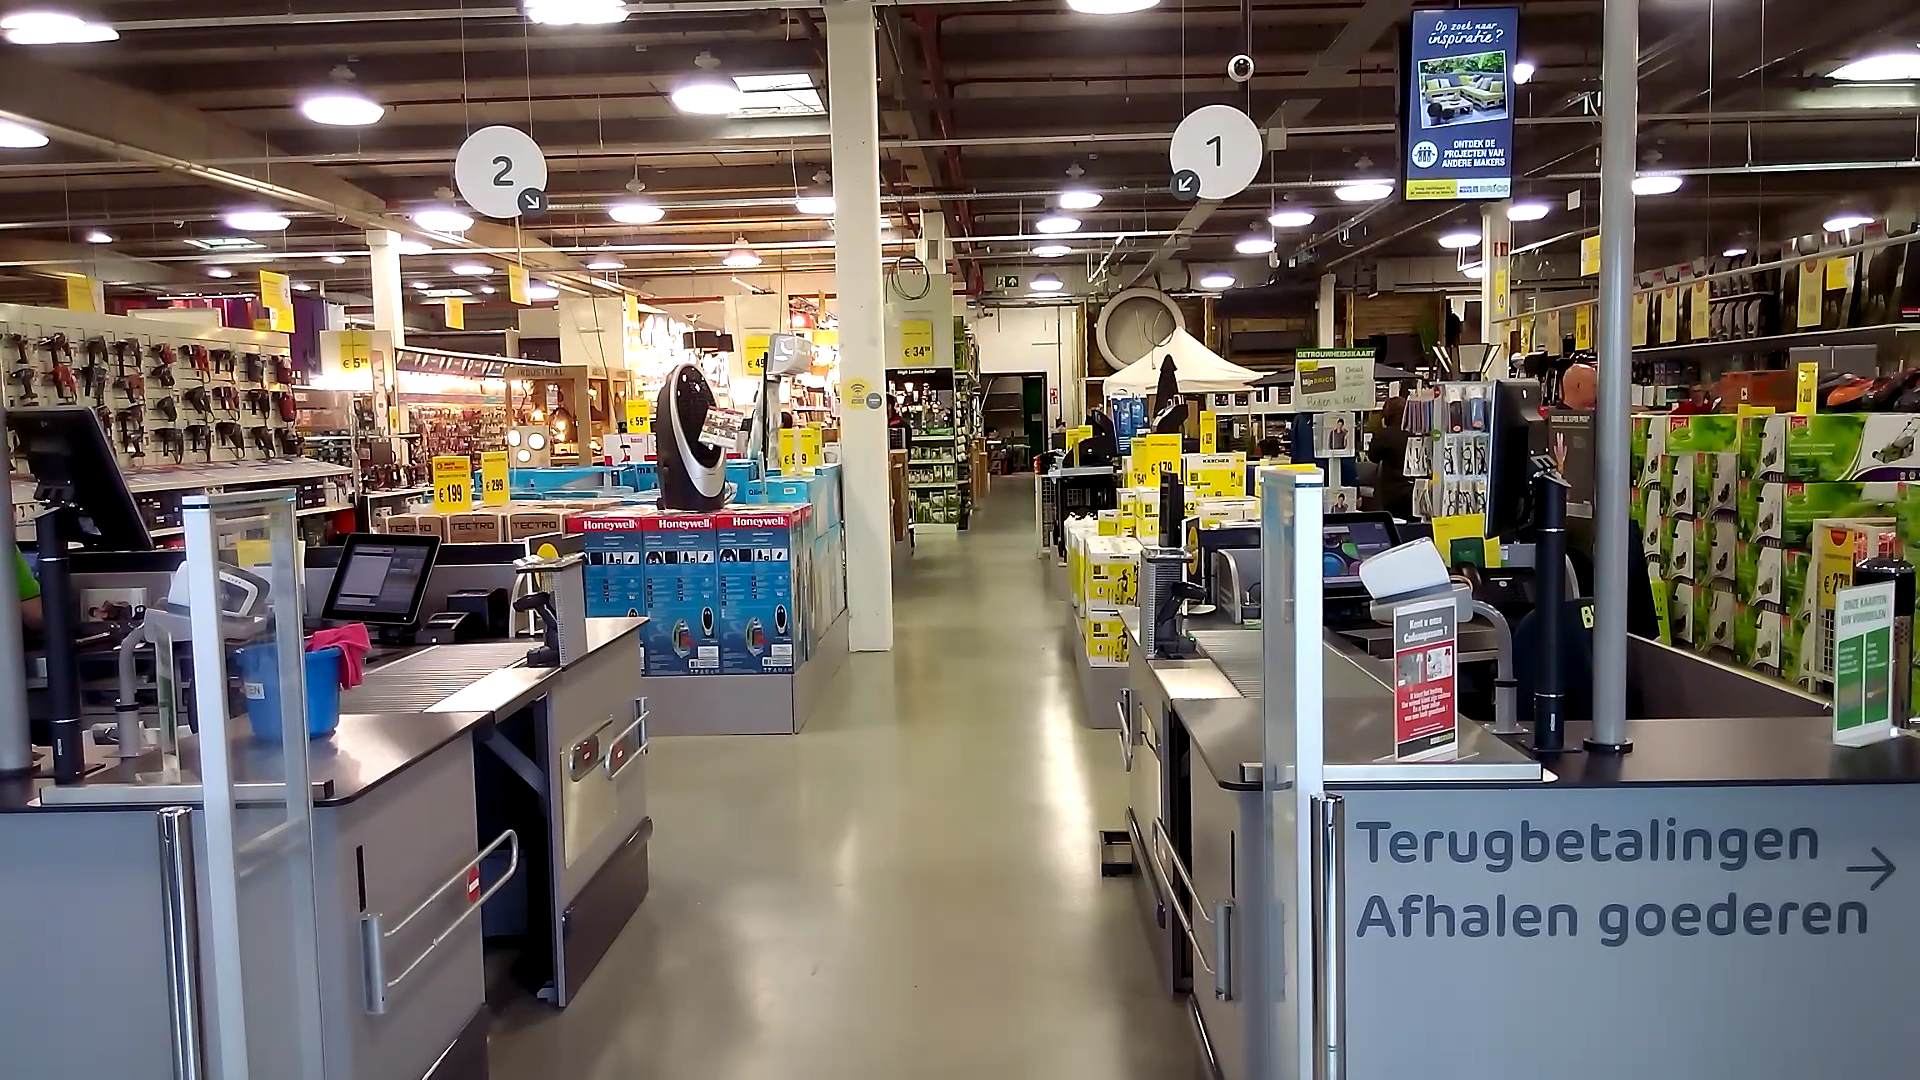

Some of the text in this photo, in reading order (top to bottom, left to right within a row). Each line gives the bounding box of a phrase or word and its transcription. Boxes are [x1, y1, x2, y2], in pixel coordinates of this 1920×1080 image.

[1435, 20, 1447, 33] Op
[1451, 20, 1473, 31] zoek
[1453, 139, 1496, 149] ONTDEK DE
[1206, 135, 1222, 167] 1
[1444, 149, 1504, 158] PROJECTEN VAN
[1442, 158, 1505, 168] ANDERE MAKERS
[492, 155, 514, 187] 2
[904, 348, 910, 357] €
[343, 360, 350, 368] €
[517, 367, 564, 376] INDUSTRIAL
[486, 481, 490, 492] €
[439, 484, 462, 503] € 199
[451, 521, 495, 531] TECTRO
[513, 521, 557, 529] TECTRO
[583, 520, 636, 531] Honeywell
[658, 519, 710, 530] Honeywell
[732, 517, 784, 528] Honeywell
[389, 524, 432, 533] TECTRO
[1824, 576, 1829, 594] €
[1356, 818, 1818, 873] Terugbetalingen
[1356, 892, 1868, 948] Afhalen goederen
